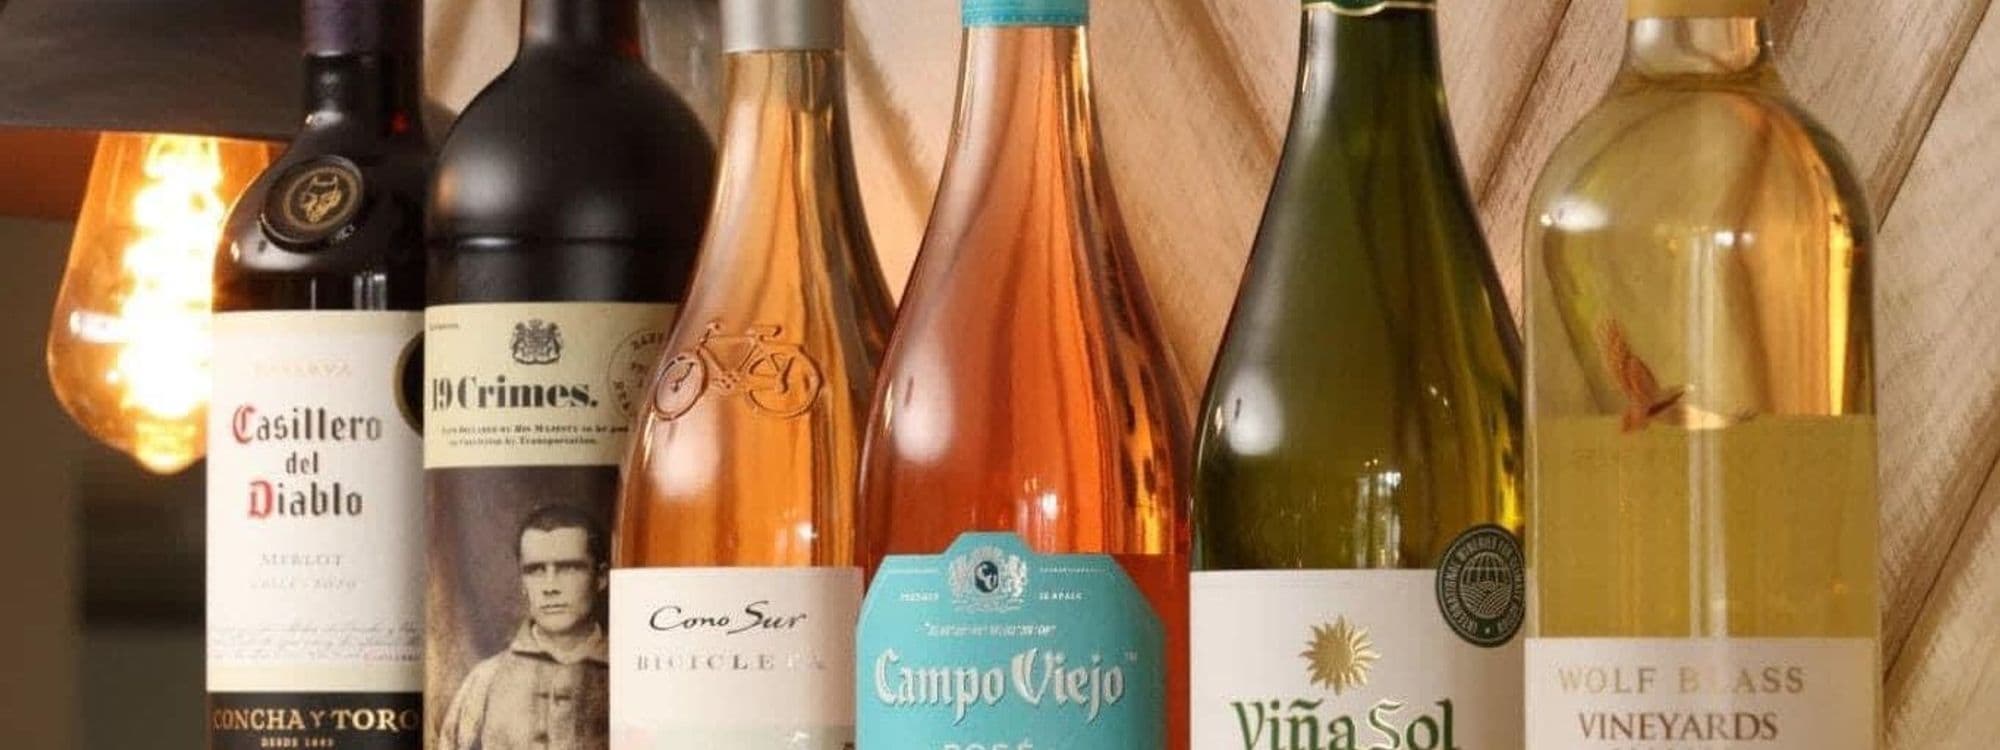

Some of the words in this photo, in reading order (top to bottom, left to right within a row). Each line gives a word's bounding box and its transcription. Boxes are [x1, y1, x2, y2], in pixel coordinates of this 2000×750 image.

[432, 377, 451, 412] 19
[457, 374, 598, 409] Crimes.
[232, 403, 382, 444] Casillero
[285, 451, 318, 474] del
[248, 480, 363, 518] Diablo
[649, 605, 730, 631] Cono
[727, 600, 807, 635] Sur
[875, 648, 1006, 727] Campo
[1011, 648, 1125, 727] Viejo
[1558, 667, 1657, 694] WOLF
[1678, 667, 1806, 694] BASS
[212, 707, 305, 731] CONCHA
[309, 710, 325, 730] Y
[331, 707, 420, 732] TORO
[1230, 698, 1357, 750] Viña
[1367, 698, 1461, 750] Sol
[1578, 711, 1779, 742] VINEYARDS
